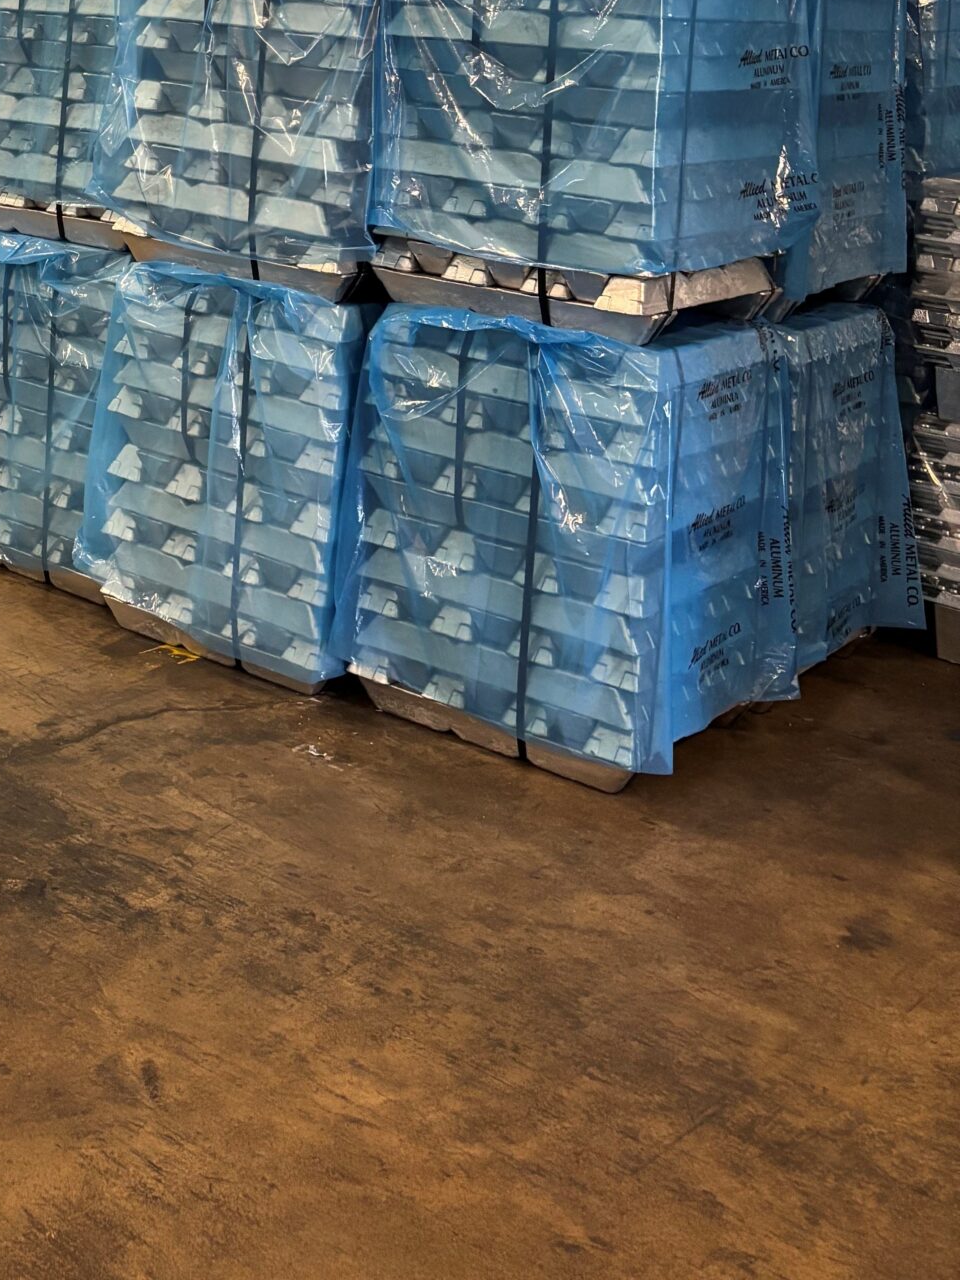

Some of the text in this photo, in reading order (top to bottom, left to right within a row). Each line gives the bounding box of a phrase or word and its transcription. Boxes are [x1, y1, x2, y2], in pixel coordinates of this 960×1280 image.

[885, 109, 897, 162] ALUMINUM
[738, 179, 766, 201] Allied
[793, 202, 818, 213] AMERICA
[757, 530, 769, 607] MADE IN AMERICA
[769, 537, 784, 599] ALUMINUM
[889, 522, 901, 576] ALUMINUM
[905, 543, 918, 583] METAL
[906, 585, 919, 608] CO.
